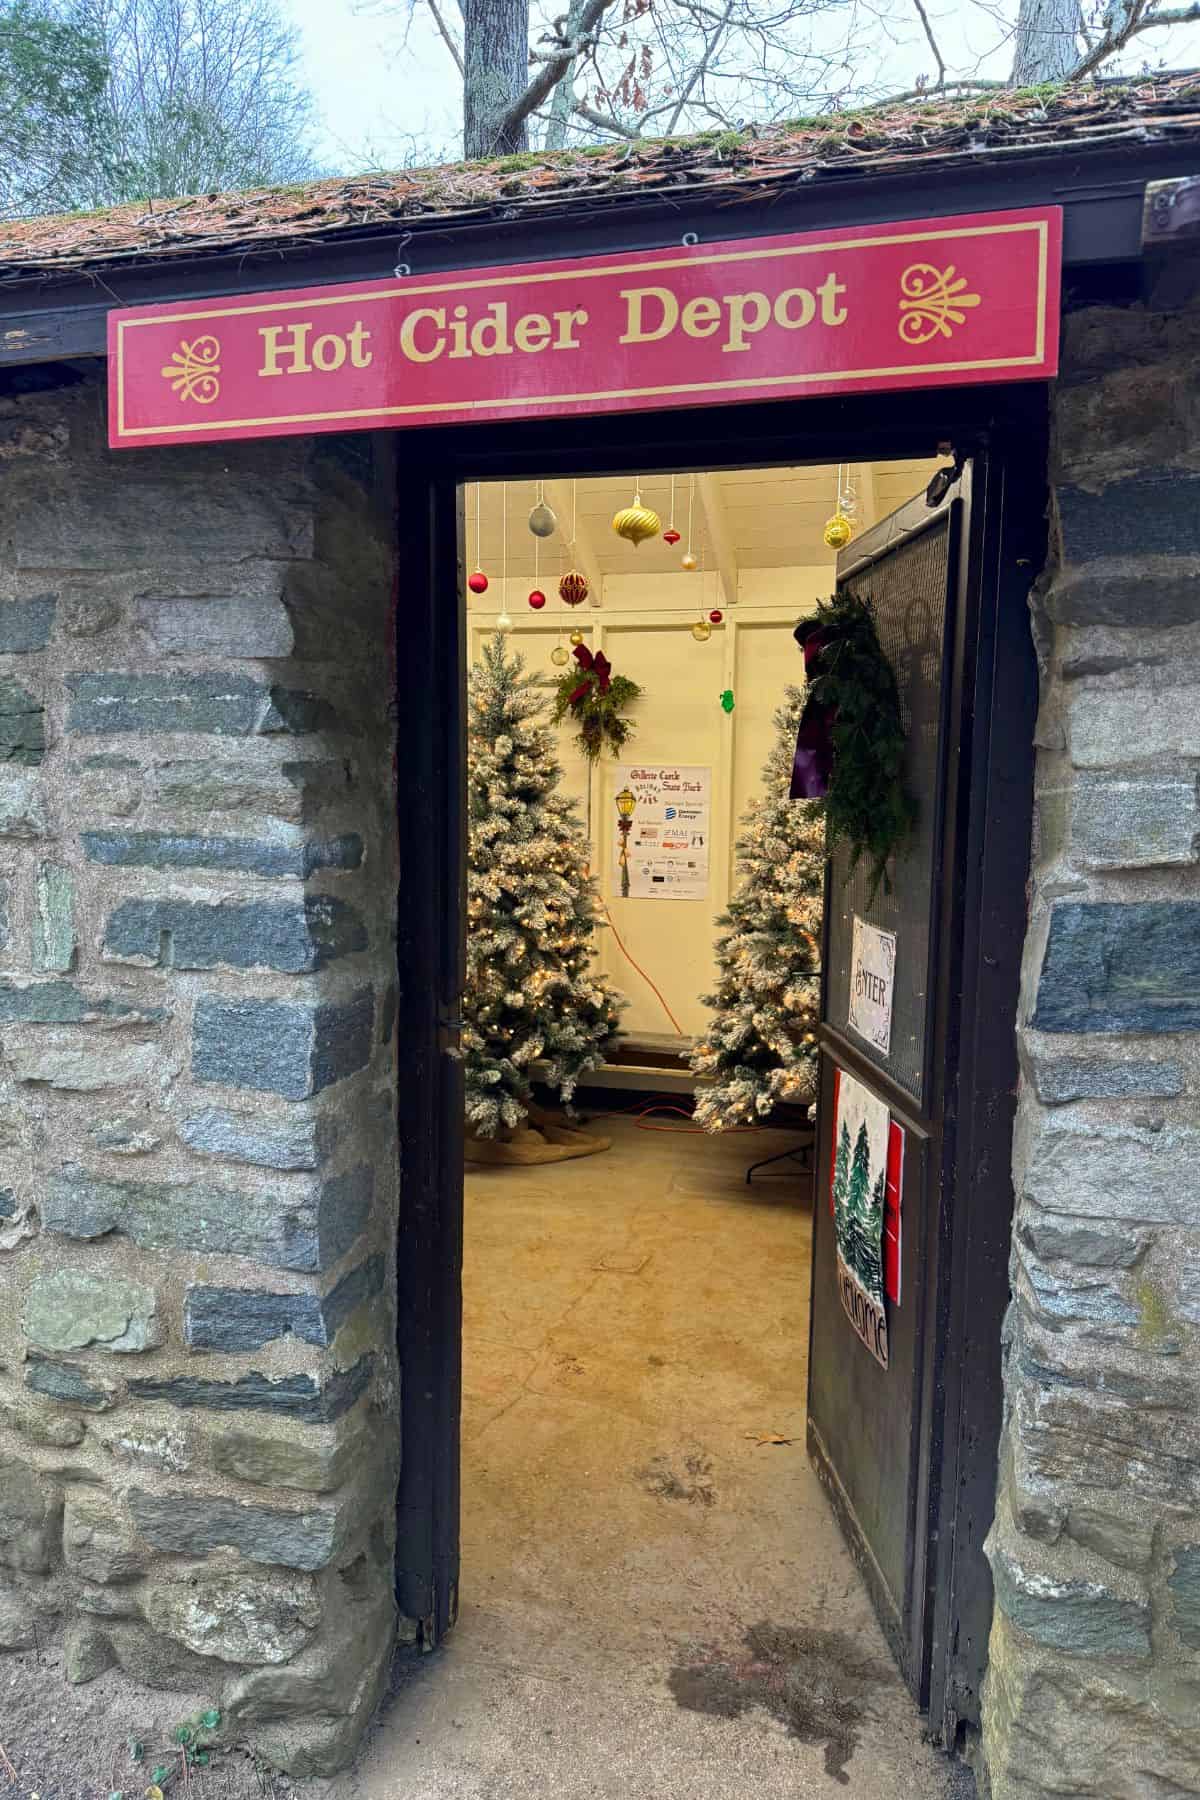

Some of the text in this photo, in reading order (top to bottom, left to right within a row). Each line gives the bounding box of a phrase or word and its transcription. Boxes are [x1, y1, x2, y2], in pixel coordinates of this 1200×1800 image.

[257, 272, 848, 377] Hot Cider Depot
